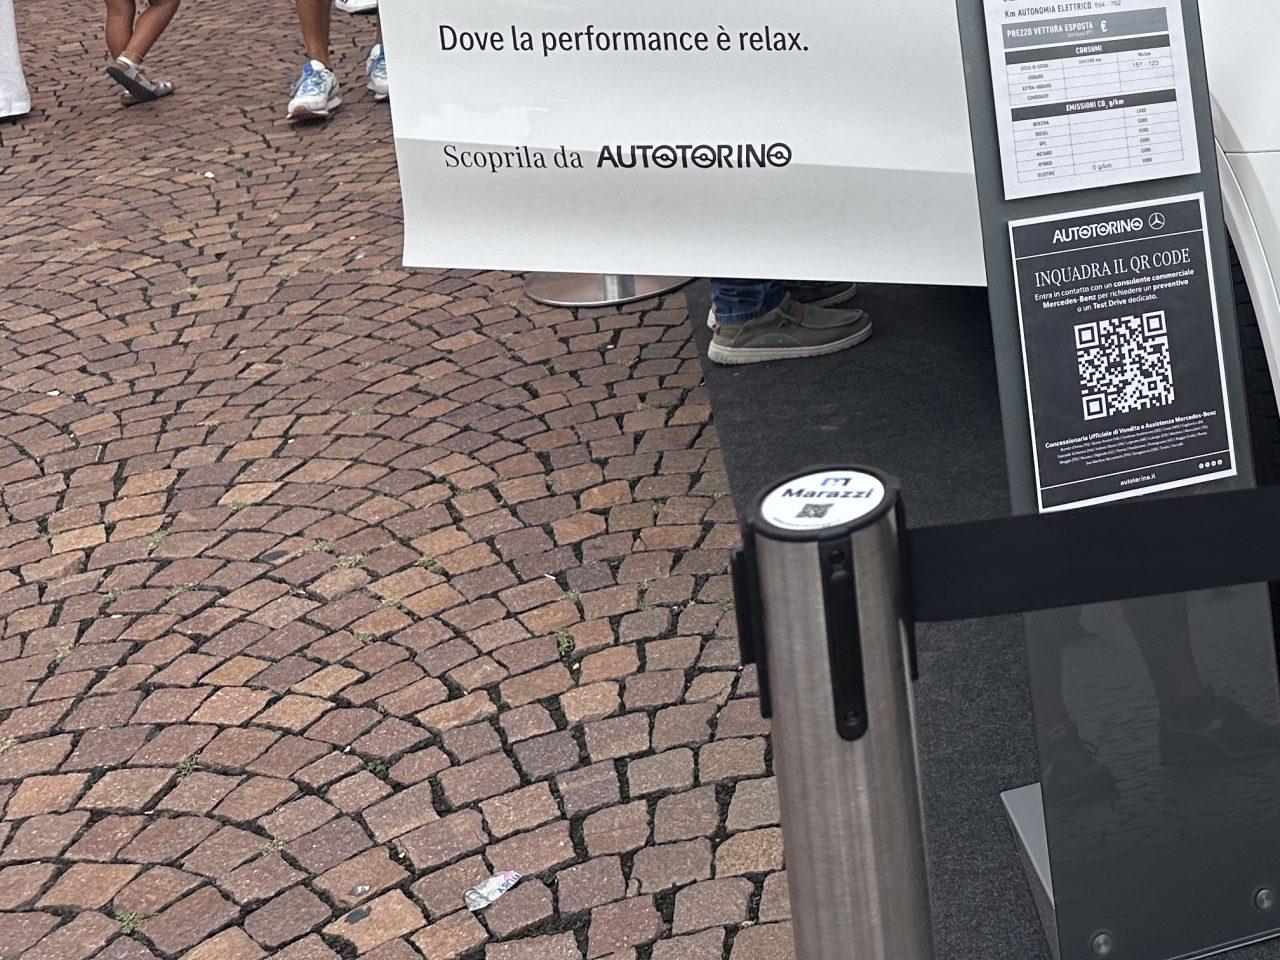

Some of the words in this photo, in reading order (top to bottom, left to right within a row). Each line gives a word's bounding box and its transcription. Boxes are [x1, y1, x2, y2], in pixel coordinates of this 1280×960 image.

[1004, 10, 1015, 18] Km
[1017, 5, 1055, 16] AUTONOMIA
[1057, 2, 1091, 12] ELETTRICO
[1006, 27, 1032, 38] PREZZO
[1033, 24, 1063, 35] VETTURA
[1064, 21, 1093, 31] ESPOSTA
[1100, 20, 1107, 32] €
[439, 25, 504, 51] Dove
[511, 25, 533, 51] la
[541, 25, 708, 57] performance
[716, 27, 731, 51] è
[739, 26, 809, 51] relax.
[1075, 44, 1102, 54] CONSUMI
[1065, 101, 1096, 111] EMISSIONI
[1108, 97, 1124, 107] g/km
[444, 144, 546, 173] Scoprila
[553, 145, 583, 168] da
[597, 142, 792, 168] AUTOTORINO
[1097, 162, 1112, 170] g/km
[1051, 216, 1143, 243] AUTOTORINO
[1034, 260, 1111, 289] INQUADRA
[1113, 257, 1127, 274] IL
[1129, 254, 1151, 274] QR
[1152, 247, 1190, 267] CODE
[1034, 291, 1052, 300] Entra
[1061, 285, 1089, 296] contatto
[1113, 275, 1150, 287] consulente
[1152, 268, 1194, 281] commerciale
[1043, 293, 1096, 308] Mercedes-Benz
[1097, 292, 1108, 301] per
[1109, 286, 1141, 297] richiedere
[1152, 278, 1188, 291] preventivo
[1093, 301, 1107, 309] Test
[1108, 297, 1126, 306] Drive
[1127, 292, 1157, 303] dedicato.
[1045, 434, 1088, 448] Concessionaria
[1088, 430, 1112, 440] Ufficiale
[1174, 409, 1216, 423] Mercedes-Benz
[781, 488, 874, 499] Marazzi
